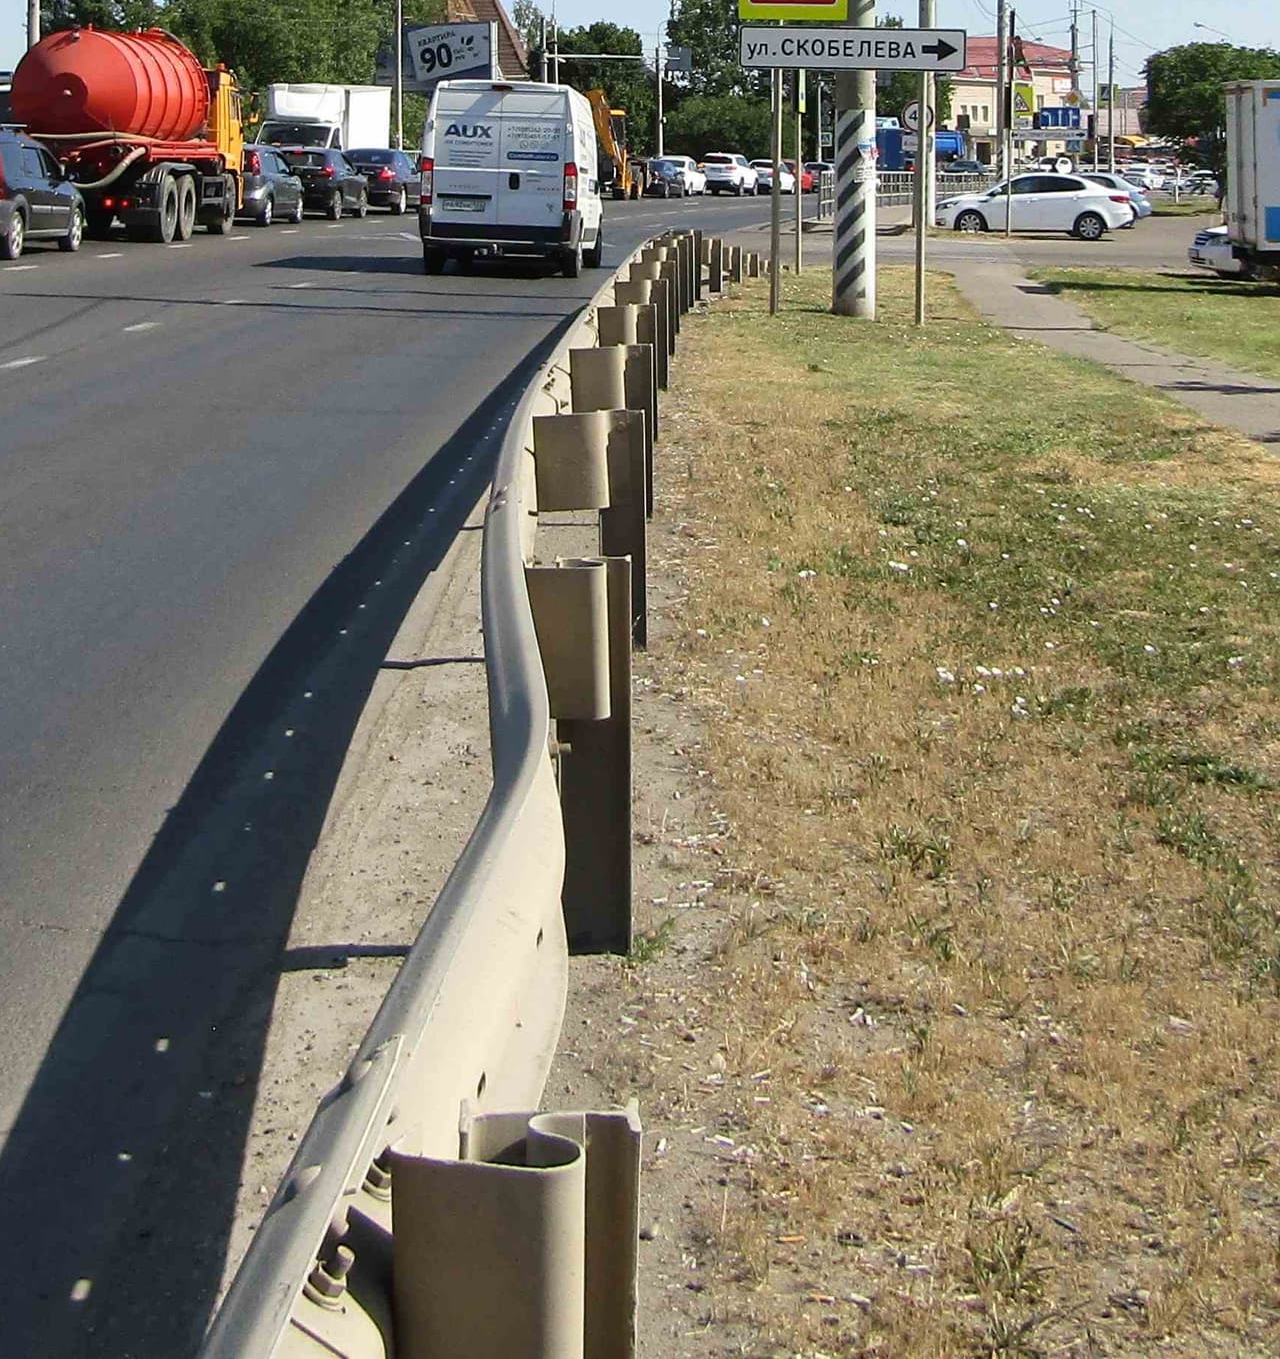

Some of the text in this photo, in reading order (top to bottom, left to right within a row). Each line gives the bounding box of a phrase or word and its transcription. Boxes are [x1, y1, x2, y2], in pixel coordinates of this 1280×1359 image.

[420, 43, 452, 73] 90
[781, 38, 916, 58] СКОБЕЛЕВА
[444, 124, 493, 139] AUX
